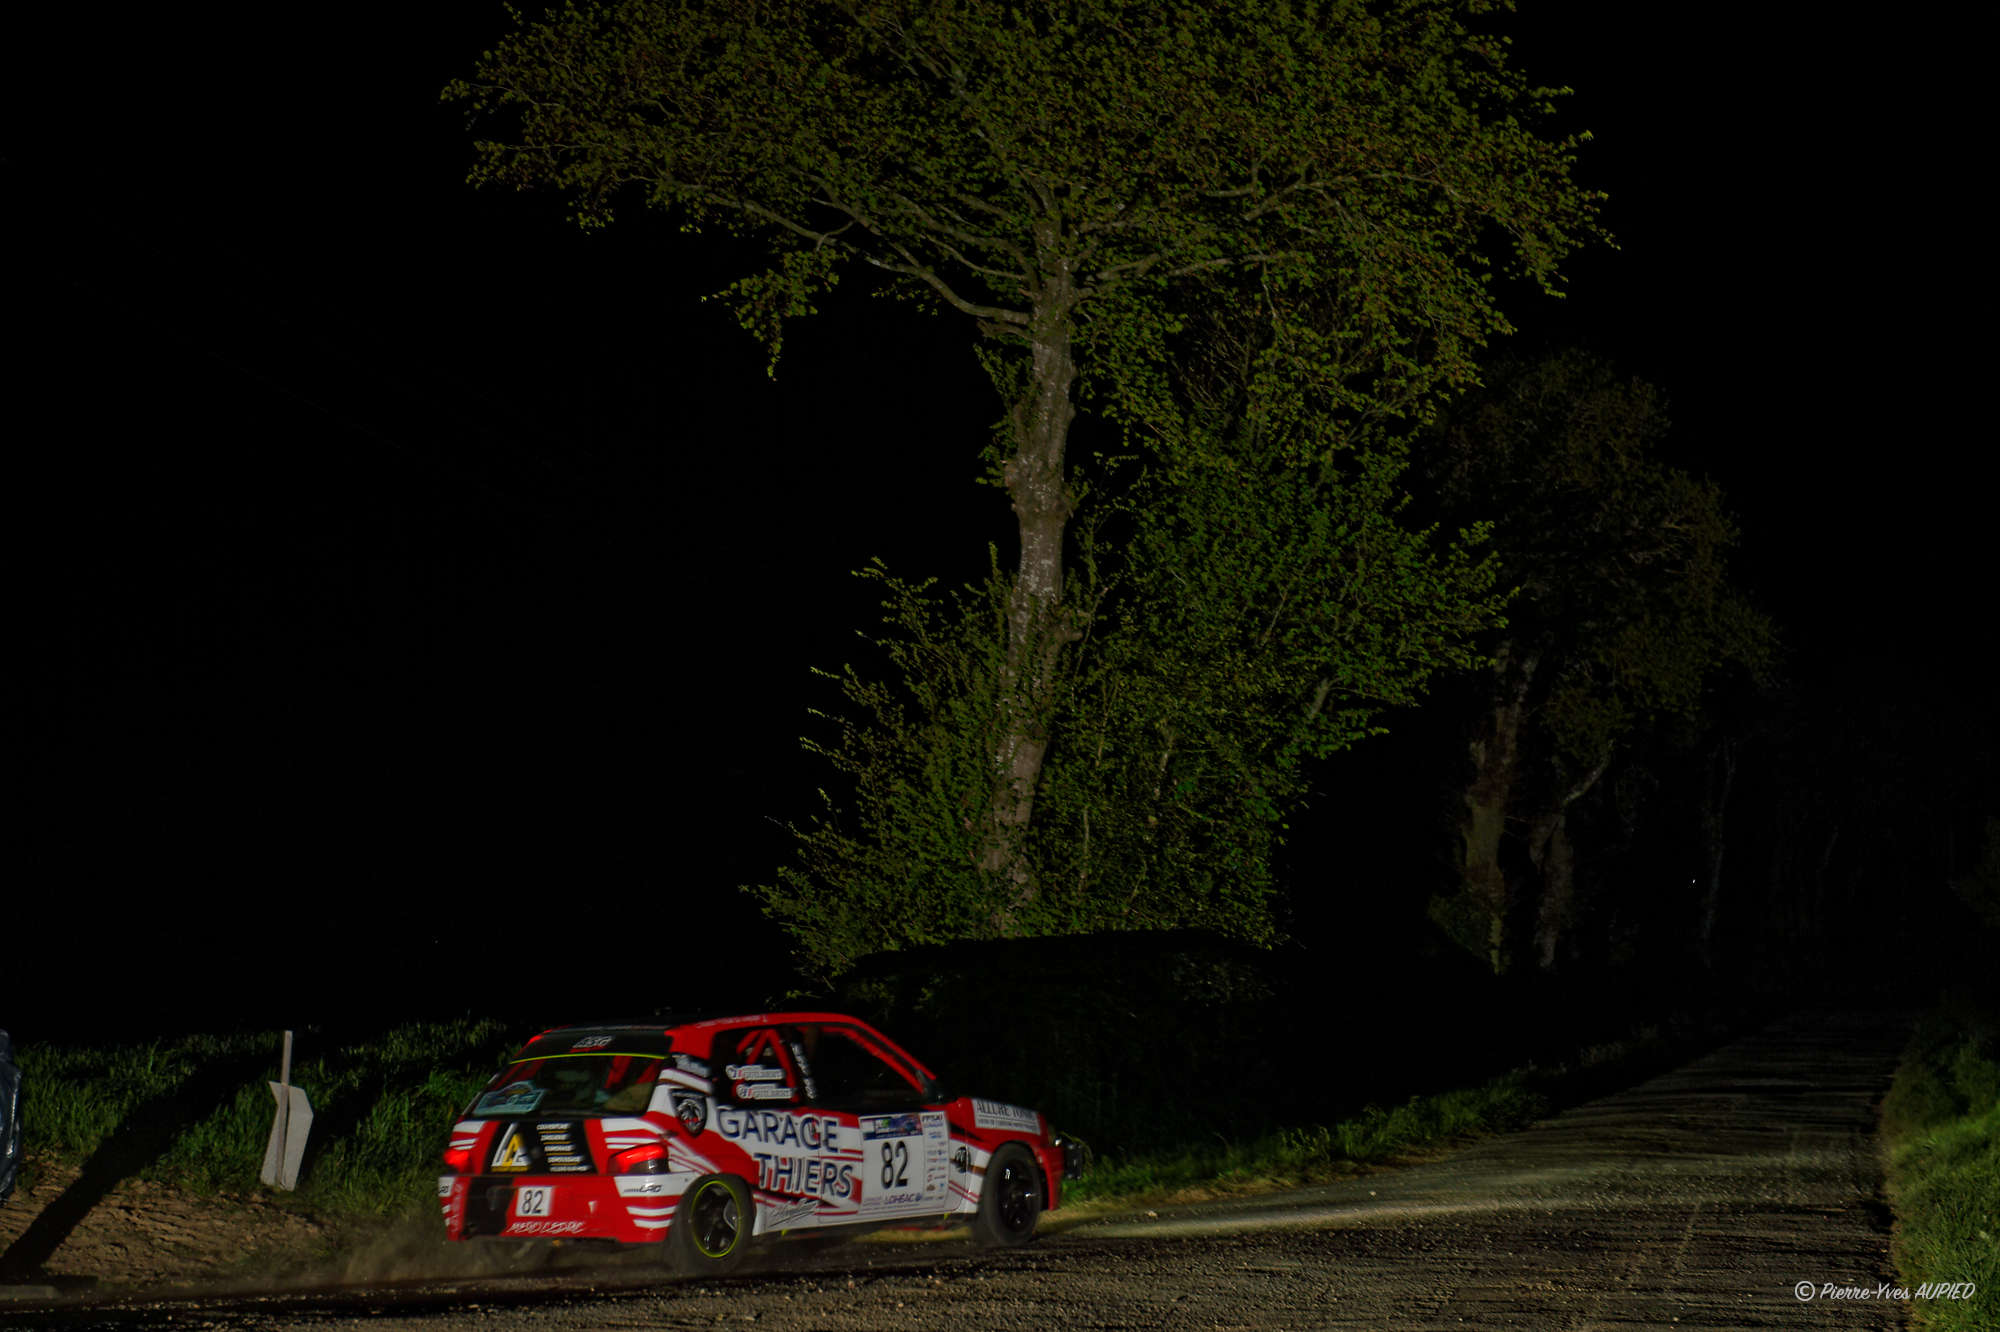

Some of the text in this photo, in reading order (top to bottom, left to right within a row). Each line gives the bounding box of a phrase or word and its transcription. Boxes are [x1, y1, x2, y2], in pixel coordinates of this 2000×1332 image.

[717, 1107, 839, 1153] GARAGE
[754, 1153, 853, 1198] THIERS
[881, 1141, 909, 1189] 82
[521, 1190, 544, 1214] 82
